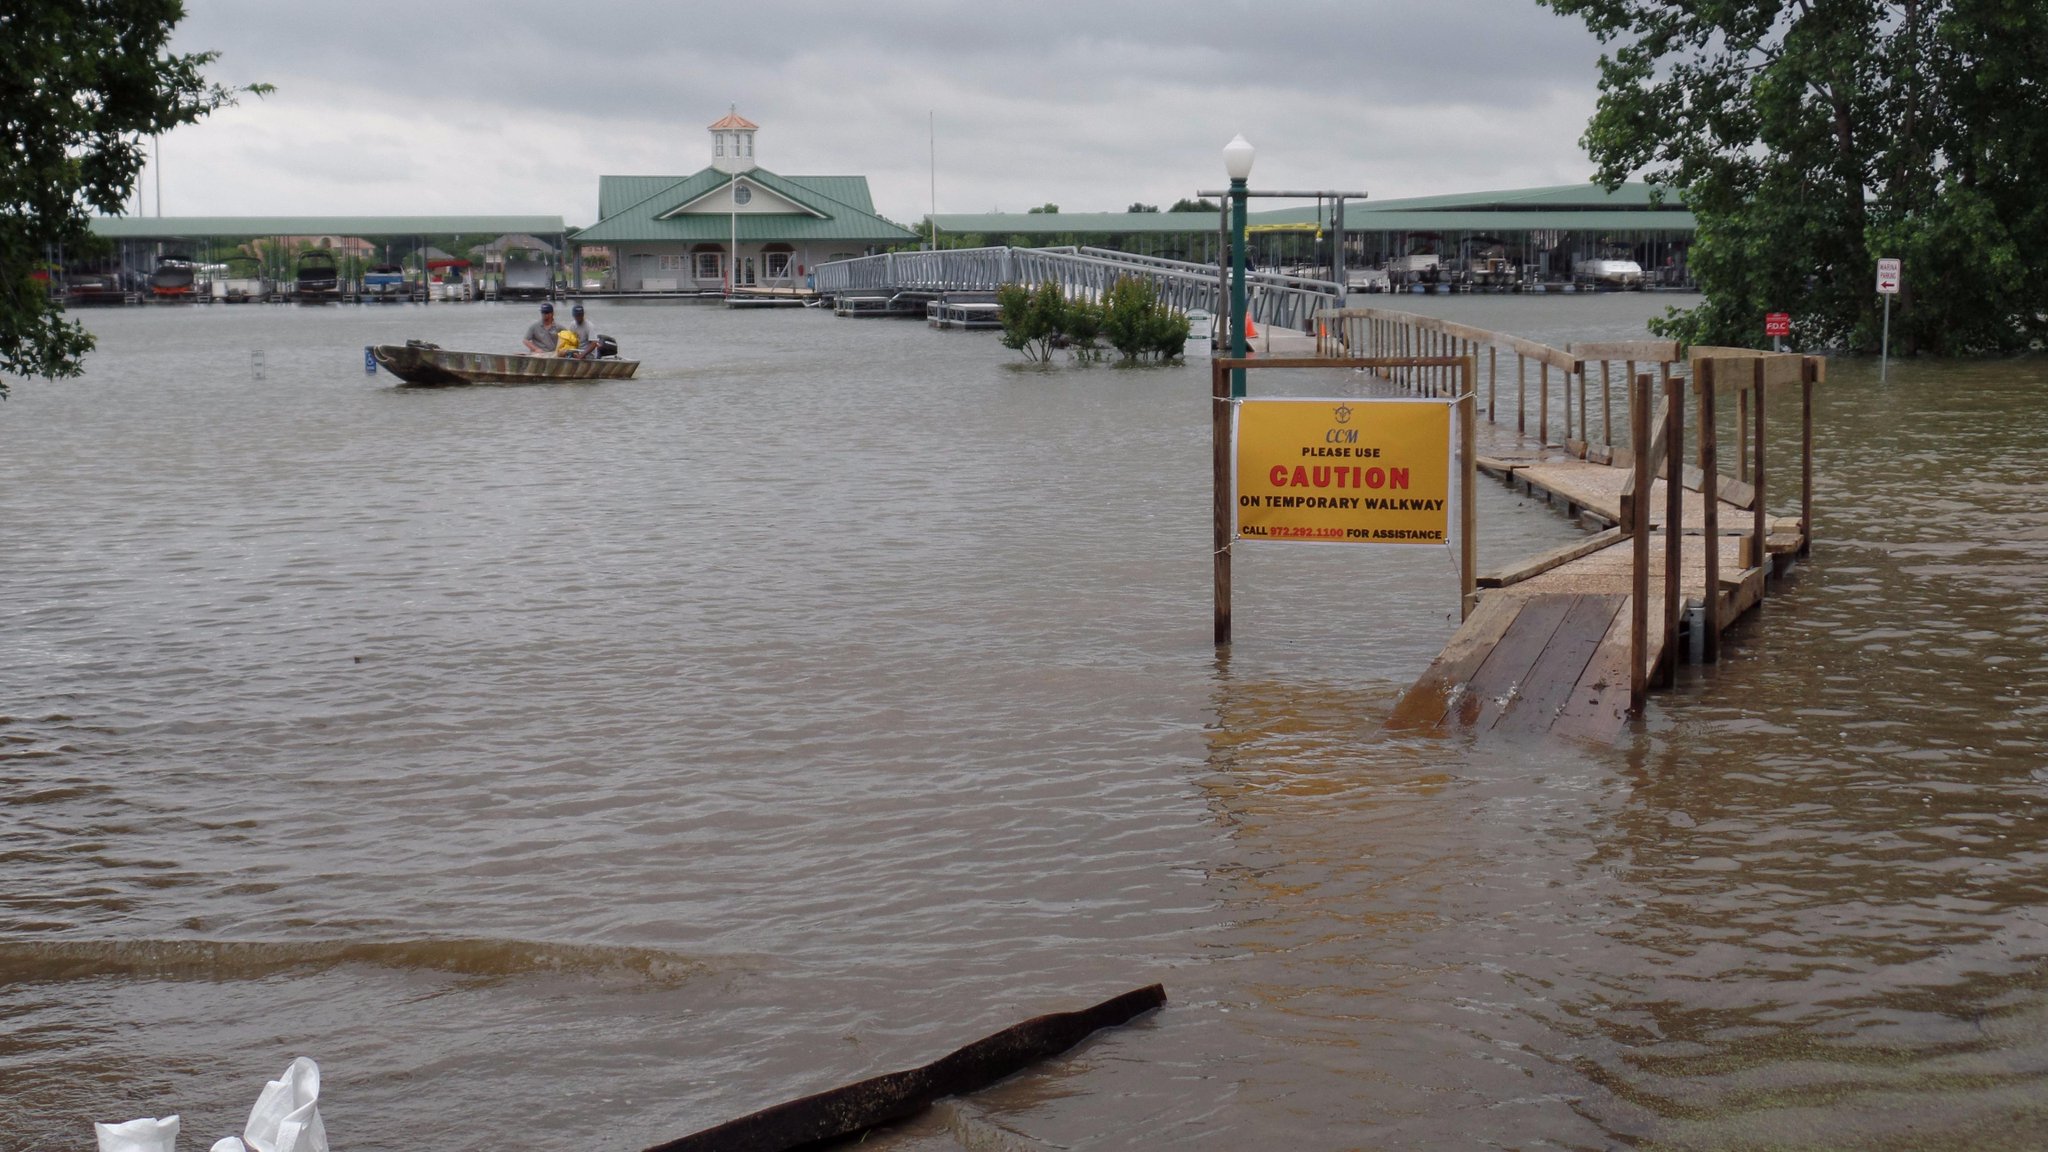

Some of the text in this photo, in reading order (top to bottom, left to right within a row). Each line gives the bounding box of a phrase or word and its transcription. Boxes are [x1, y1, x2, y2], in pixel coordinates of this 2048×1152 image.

[1880, 263, 1897, 271] MARINA
[1326, 428, 1359, 444] CCM
[1302, 447, 1380, 458] PLEASE USE
[1269, 464, 1410, 490] CAUTION
[1240, 495, 1444, 511] ON TEMPORARY WALKWAY
[1242, 526, 1268, 536] CALL
[1347, 528, 1370, 538] FOR
[1372, 529, 1442, 540] ASSISTANCE
